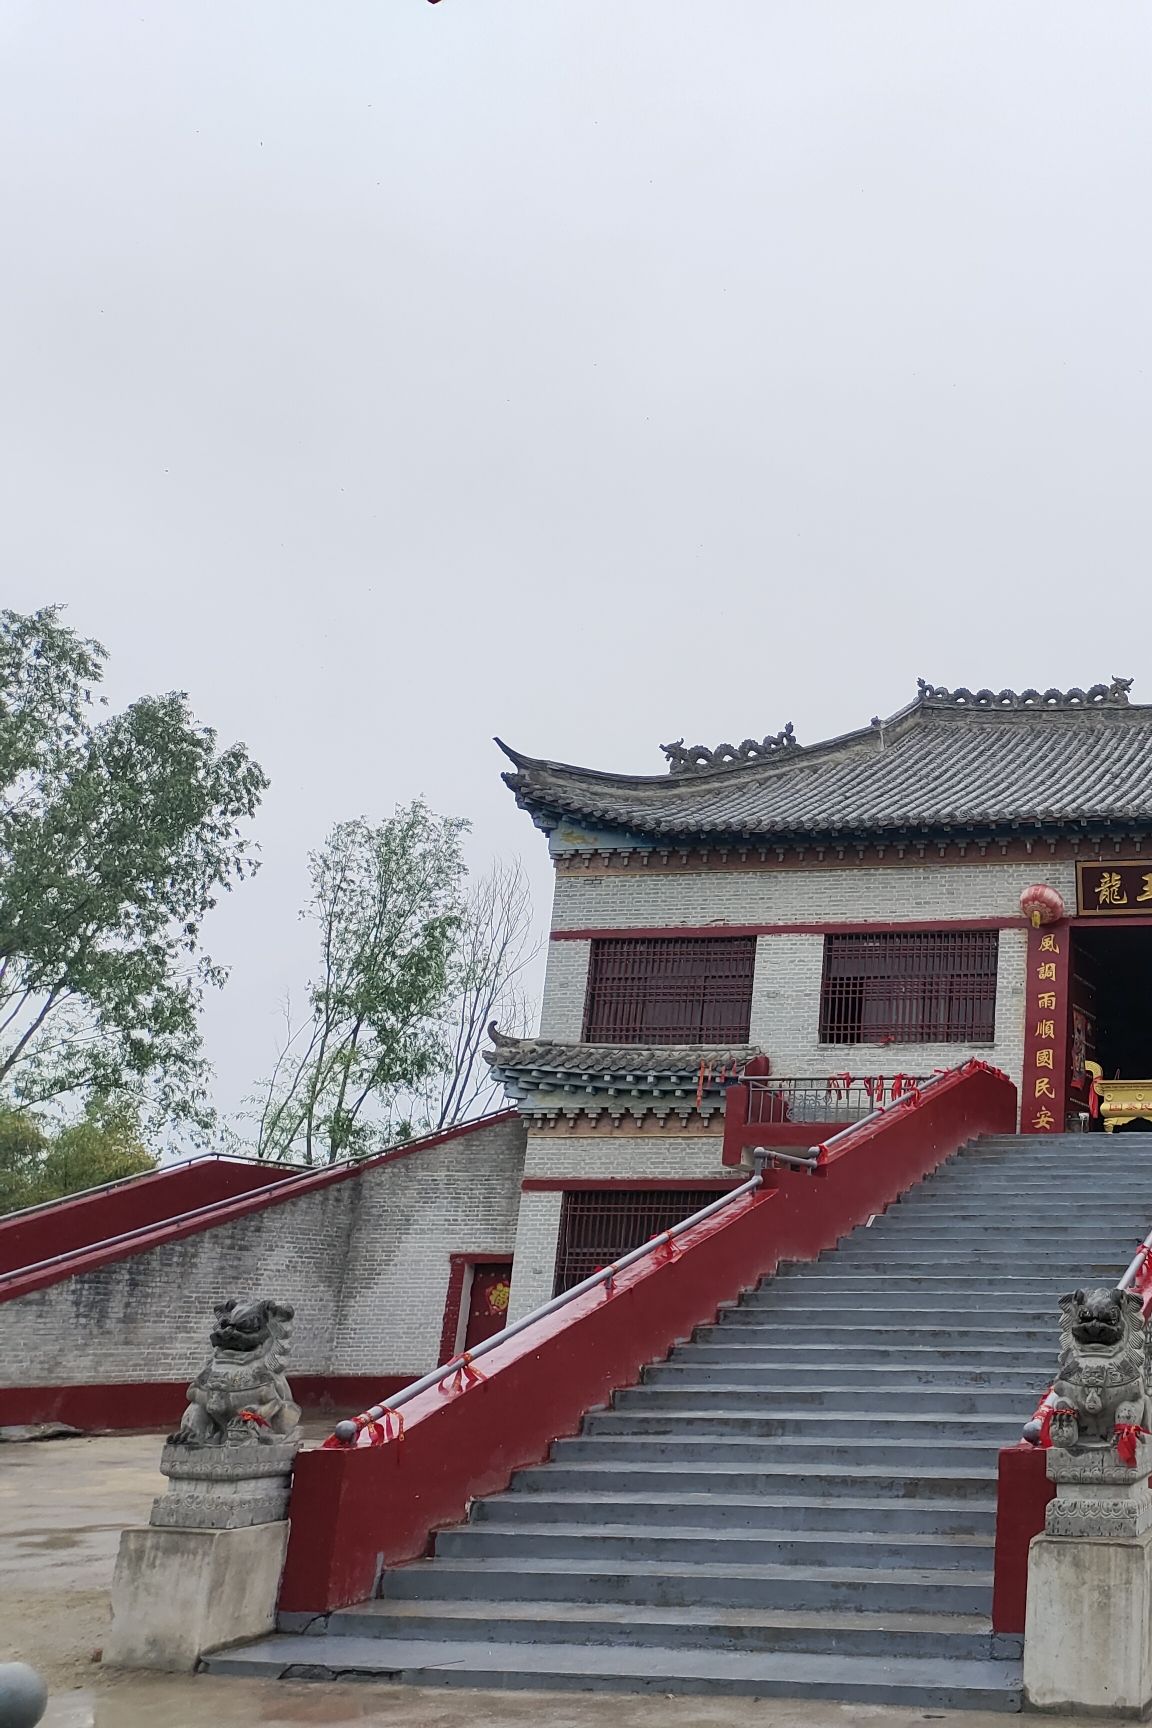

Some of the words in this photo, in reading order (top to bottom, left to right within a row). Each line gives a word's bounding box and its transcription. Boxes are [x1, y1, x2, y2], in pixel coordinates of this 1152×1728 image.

[1032, 933, 1059, 1129] 風調雨順國民安
